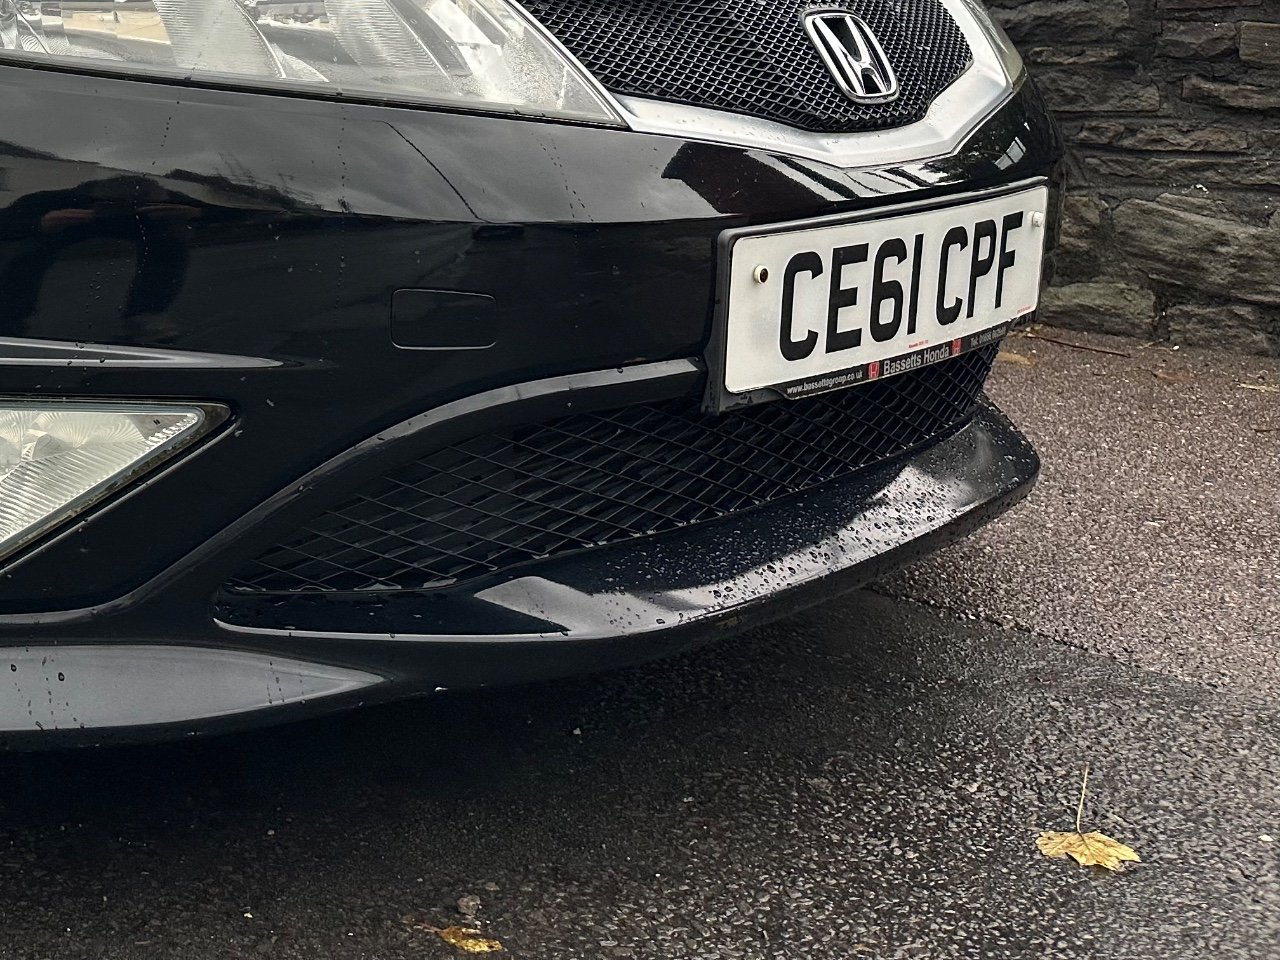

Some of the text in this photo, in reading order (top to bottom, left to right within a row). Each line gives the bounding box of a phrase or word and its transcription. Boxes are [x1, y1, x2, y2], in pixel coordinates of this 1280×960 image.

[779, 211, 1024, 362] CE61 CPF
[883, 353, 921, 376] Bassetts
[923, 344, 950, 365] Honda
